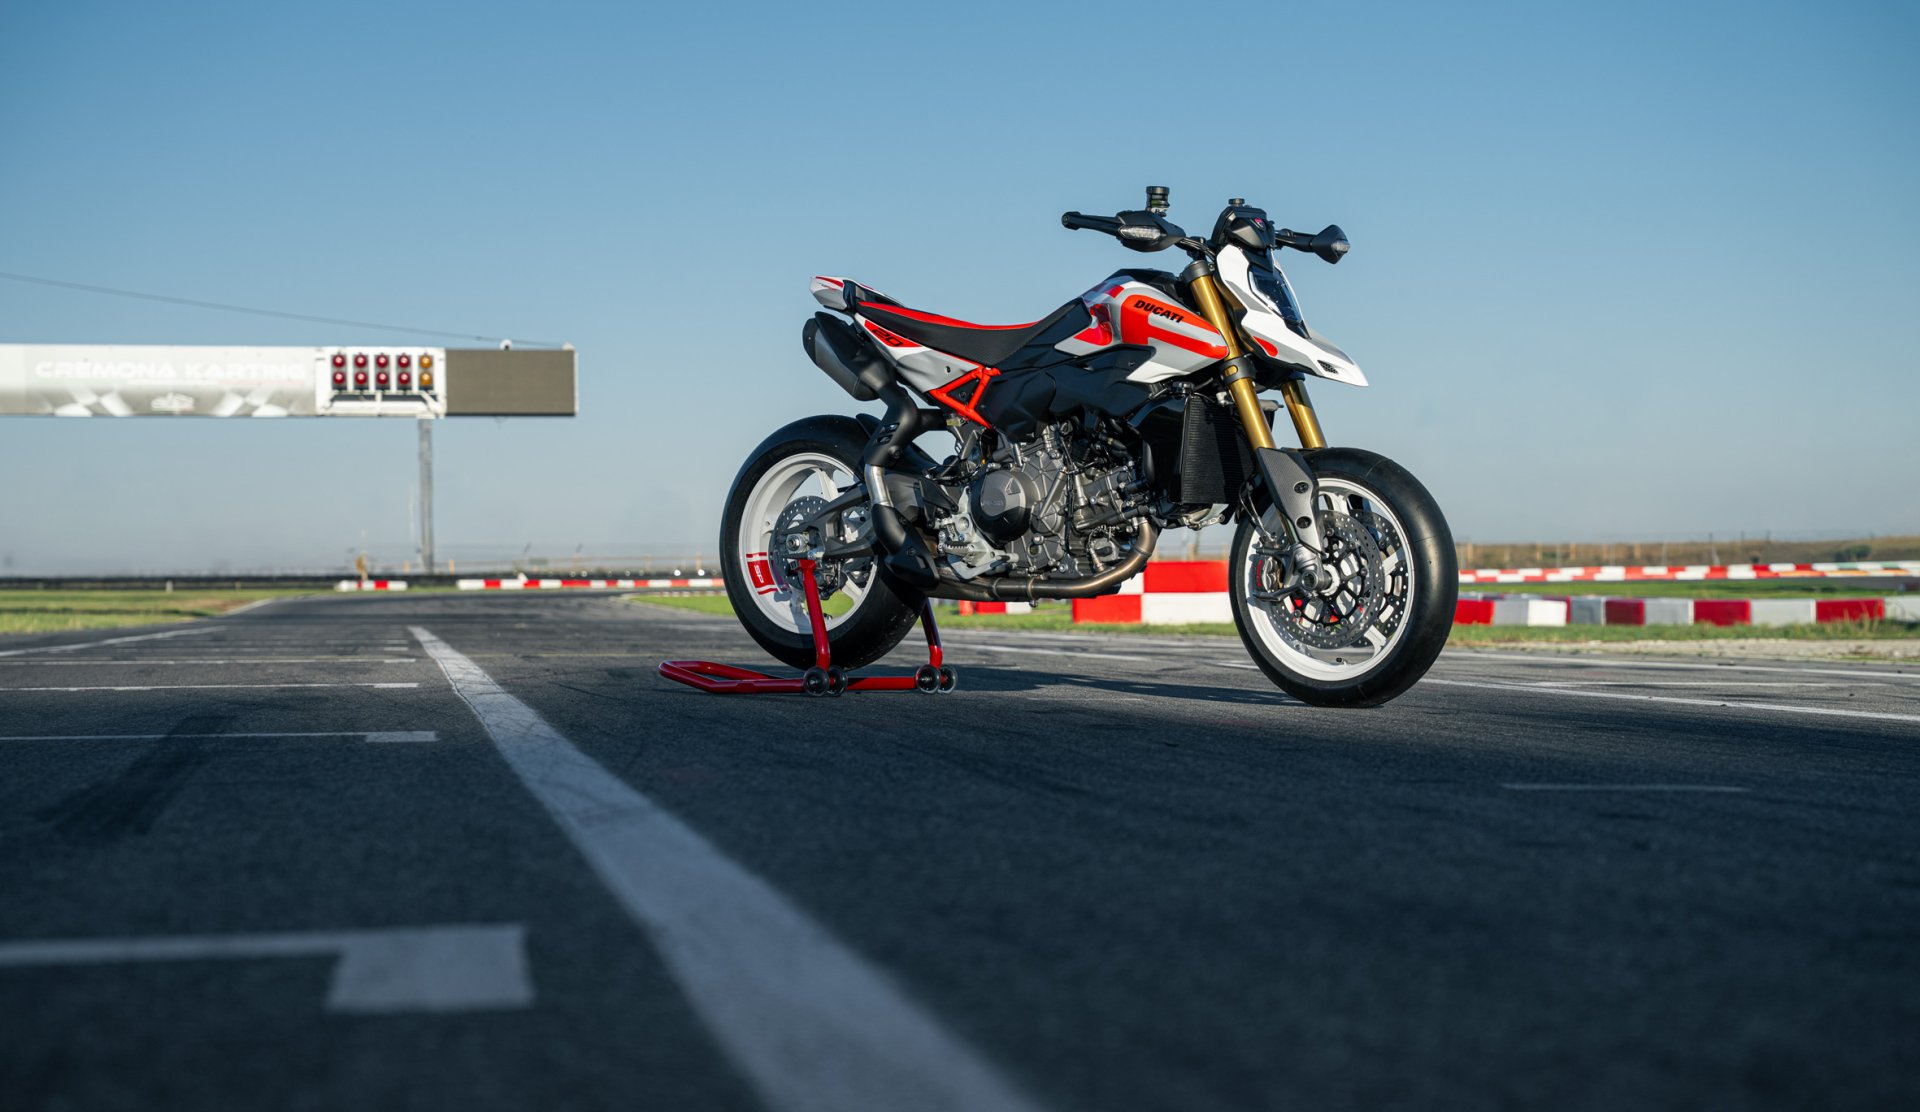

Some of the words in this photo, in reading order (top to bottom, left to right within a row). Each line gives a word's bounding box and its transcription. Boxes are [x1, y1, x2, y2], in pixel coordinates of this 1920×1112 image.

[1133, 299, 1184, 323] DUCATI
[34, 361, 177, 379] CREMONA
[185, 361, 306, 380] KARTING
